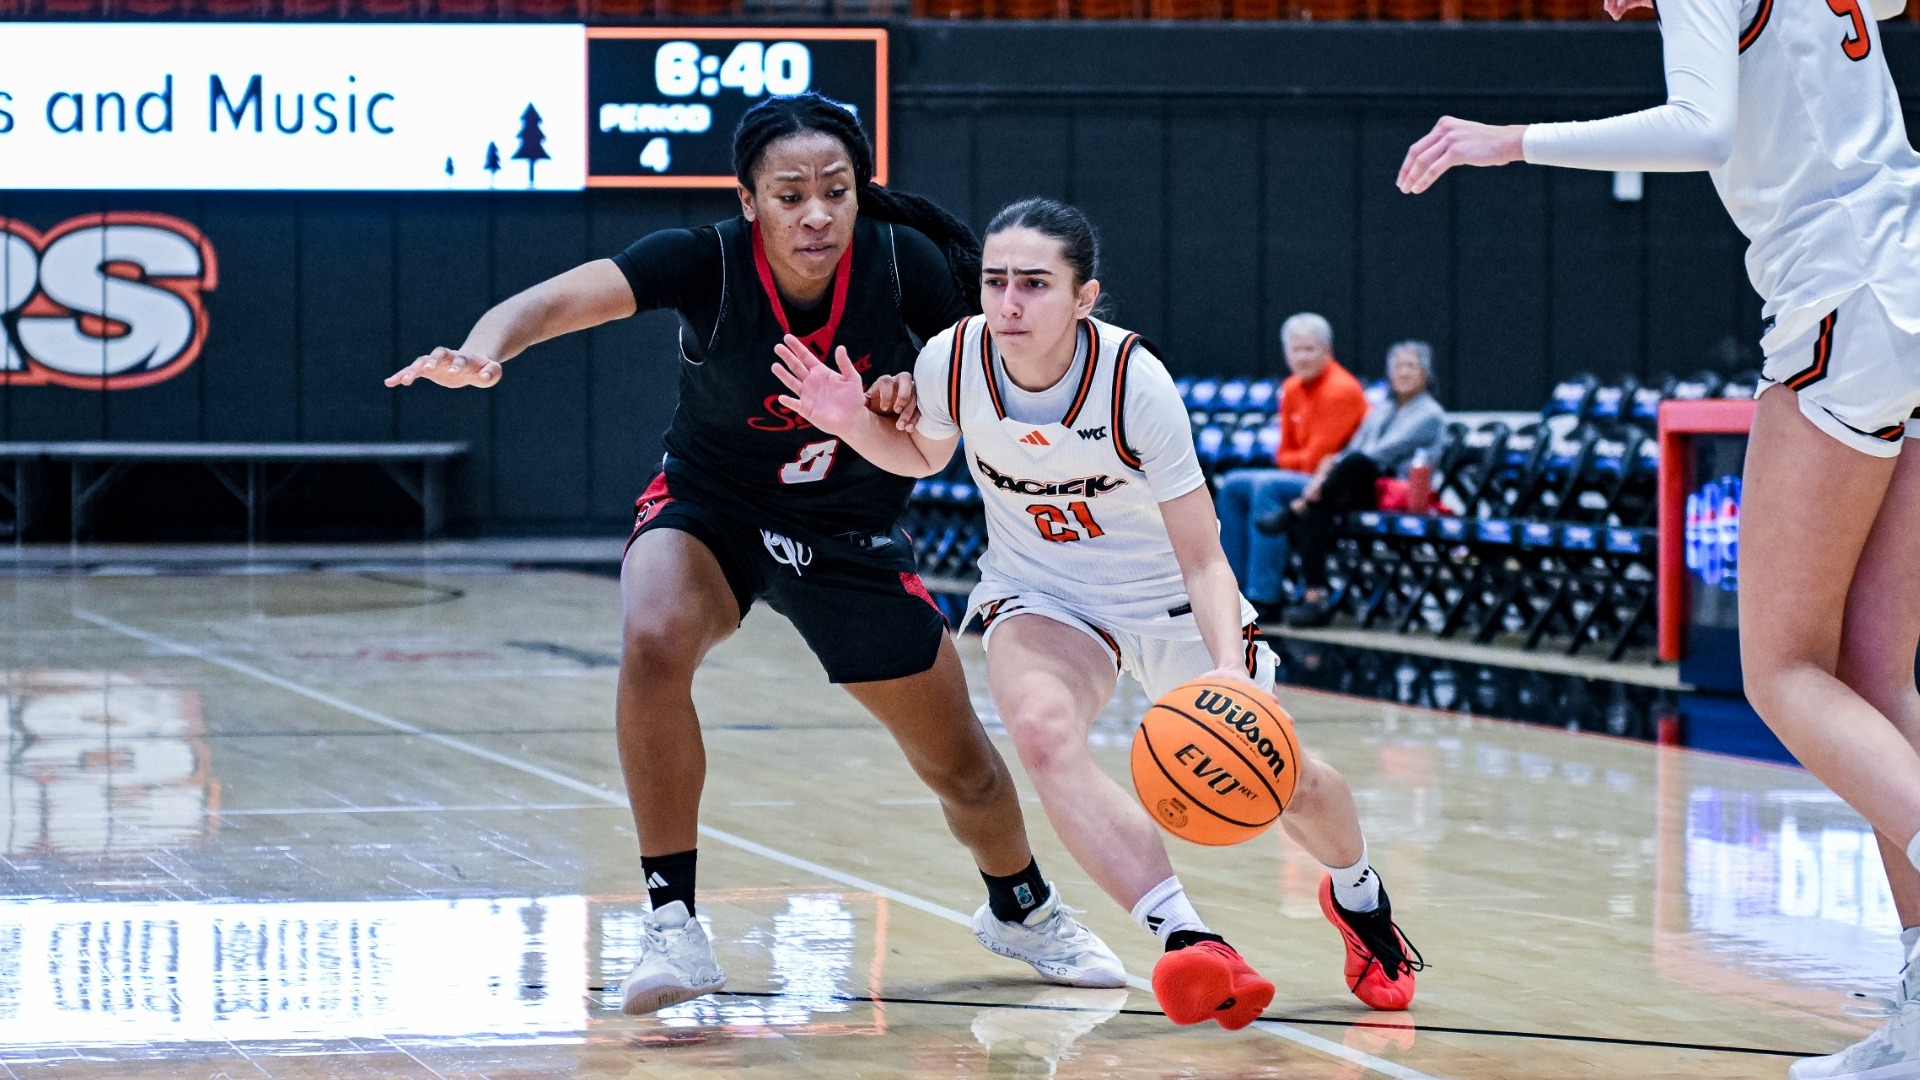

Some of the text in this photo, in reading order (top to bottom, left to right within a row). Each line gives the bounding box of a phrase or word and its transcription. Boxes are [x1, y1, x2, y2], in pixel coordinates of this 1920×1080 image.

[655, 41, 812, 96] 6:40
[46, 75, 173, 134] and
[209, 75, 395, 134] Music
[600, 104, 712, 132] PERIOD
[640, 137, 671, 171] 4
[1077, 426, 1107, 441] WCC
[1026, 501, 1105, 542] 21
[1194, 689, 1286, 778] Wilson
[1238, 787, 1259, 801] NXT
